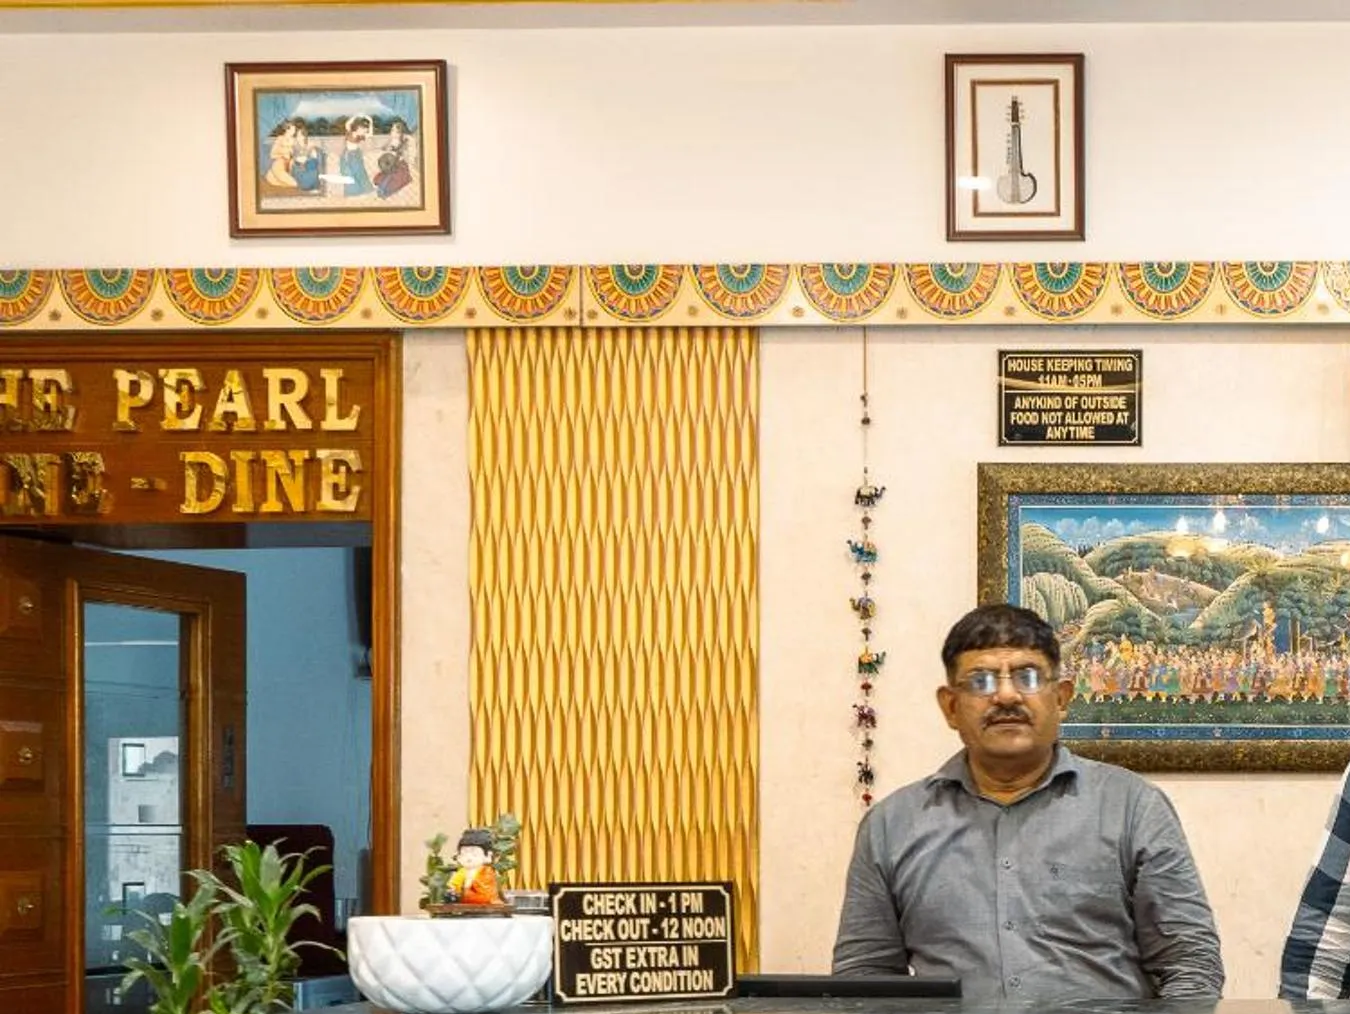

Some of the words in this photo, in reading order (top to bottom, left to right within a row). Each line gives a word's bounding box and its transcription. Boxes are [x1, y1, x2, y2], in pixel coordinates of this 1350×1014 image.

[1007, 358, 1045, 372] HOUSE
[1047, 358, 1093, 372] KEEPING
[1097, 358, 1133, 372] TIMING
[112, 368, 361, 432] PEARL
[1014, 396, 1062, 409] ANYKIND
[1064, 396, 1078, 409] OF
[1081, 396, 1127, 409] OUTSIDE
[1010, 412, 1039, 425] FOOD
[1041, 412, 1063, 425] NOT
[1065, 412, 1115, 425] ALLOWED
[1116, 412, 1129, 425] AT
[1045, 426, 1096, 440] ANYTIME
[179, 449, 363, 514] DINE
[582, 893, 637, 915] CHECK
[640, 892, 657, 914] IN
[668, 892, 677, 913] 1
[681, 892, 703, 913] PM
[560, 919, 616, 942] CHECK
[617, 918, 650, 941] OUT
[661, 917, 679, 939] 12
[682, 916, 726, 938] NOON
[590, 946, 623, 969] GST
[626, 946, 679, 968] EXTRA
[683, 945, 699, 966] IN
[575, 973, 627, 995] EVERY
[629, 970, 714, 993] CONDITION
